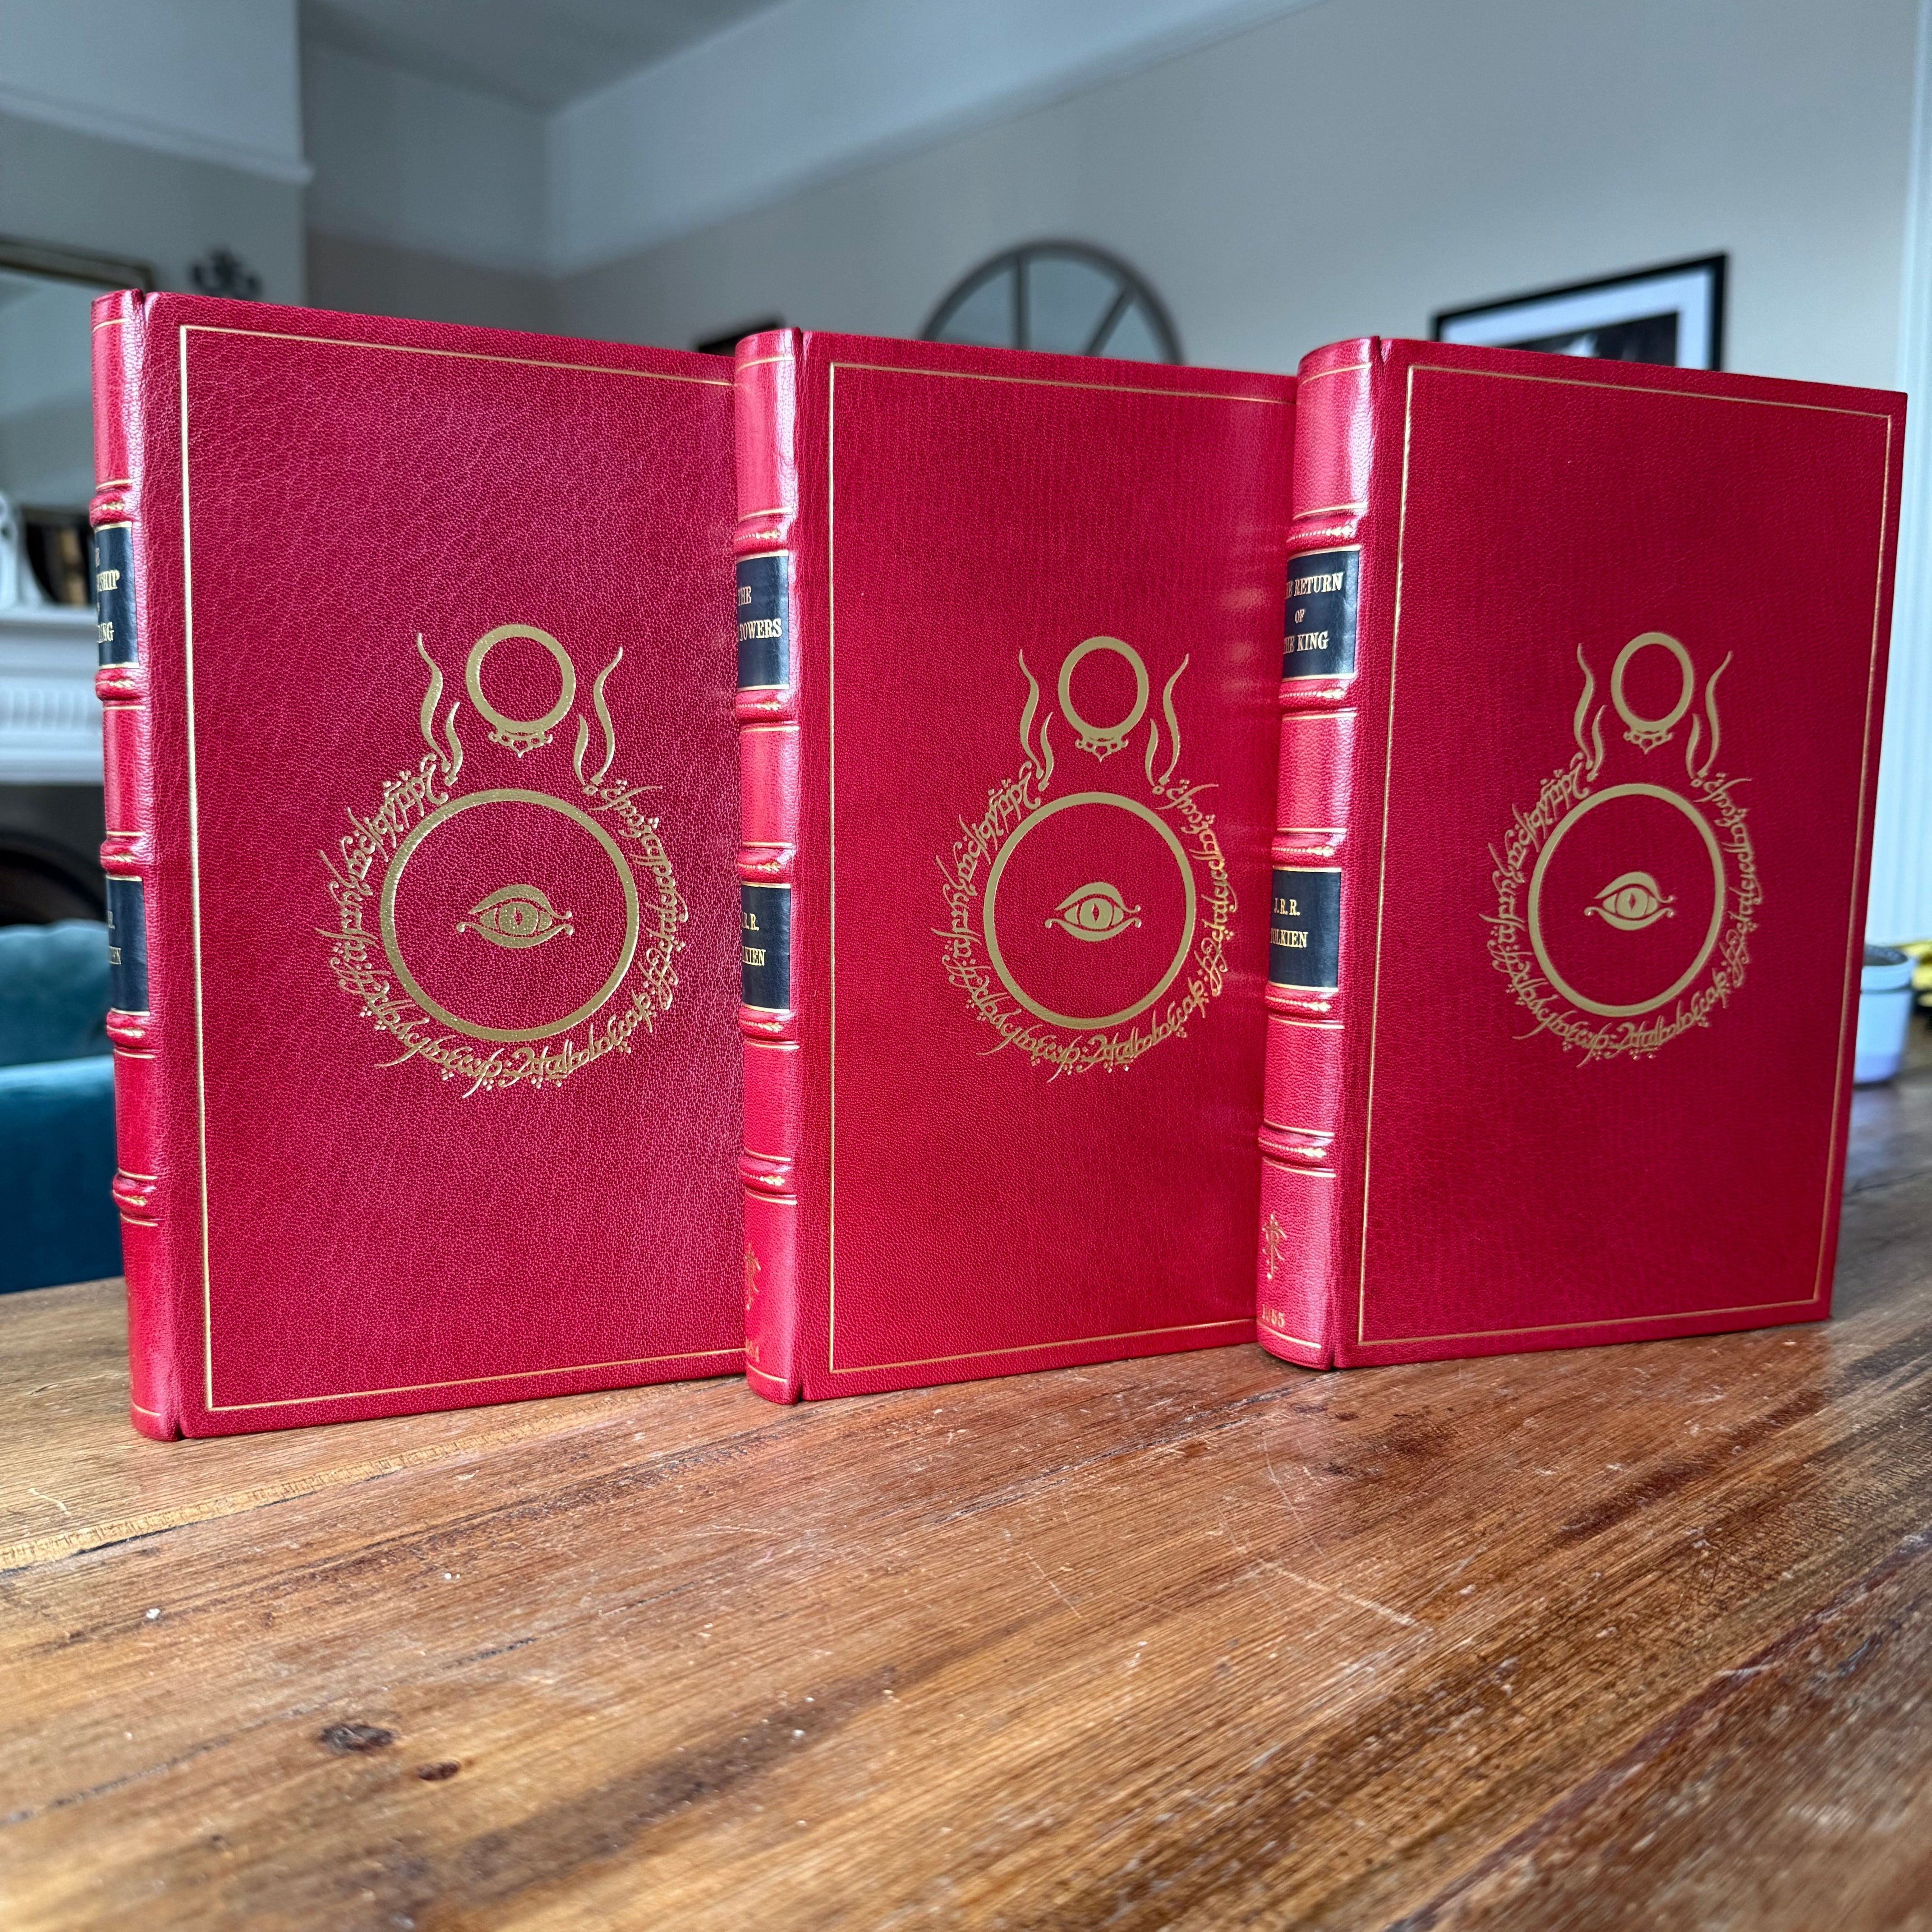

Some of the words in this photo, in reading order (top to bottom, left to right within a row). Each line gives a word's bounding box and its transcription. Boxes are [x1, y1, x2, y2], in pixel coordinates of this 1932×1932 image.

[1294, 571, 1343, 596] RETURN
[1295, 609, 1305, 624] OF
[1297, 630, 1330, 652] KING
[1270, 928, 1309, 948] TOLKIEN
